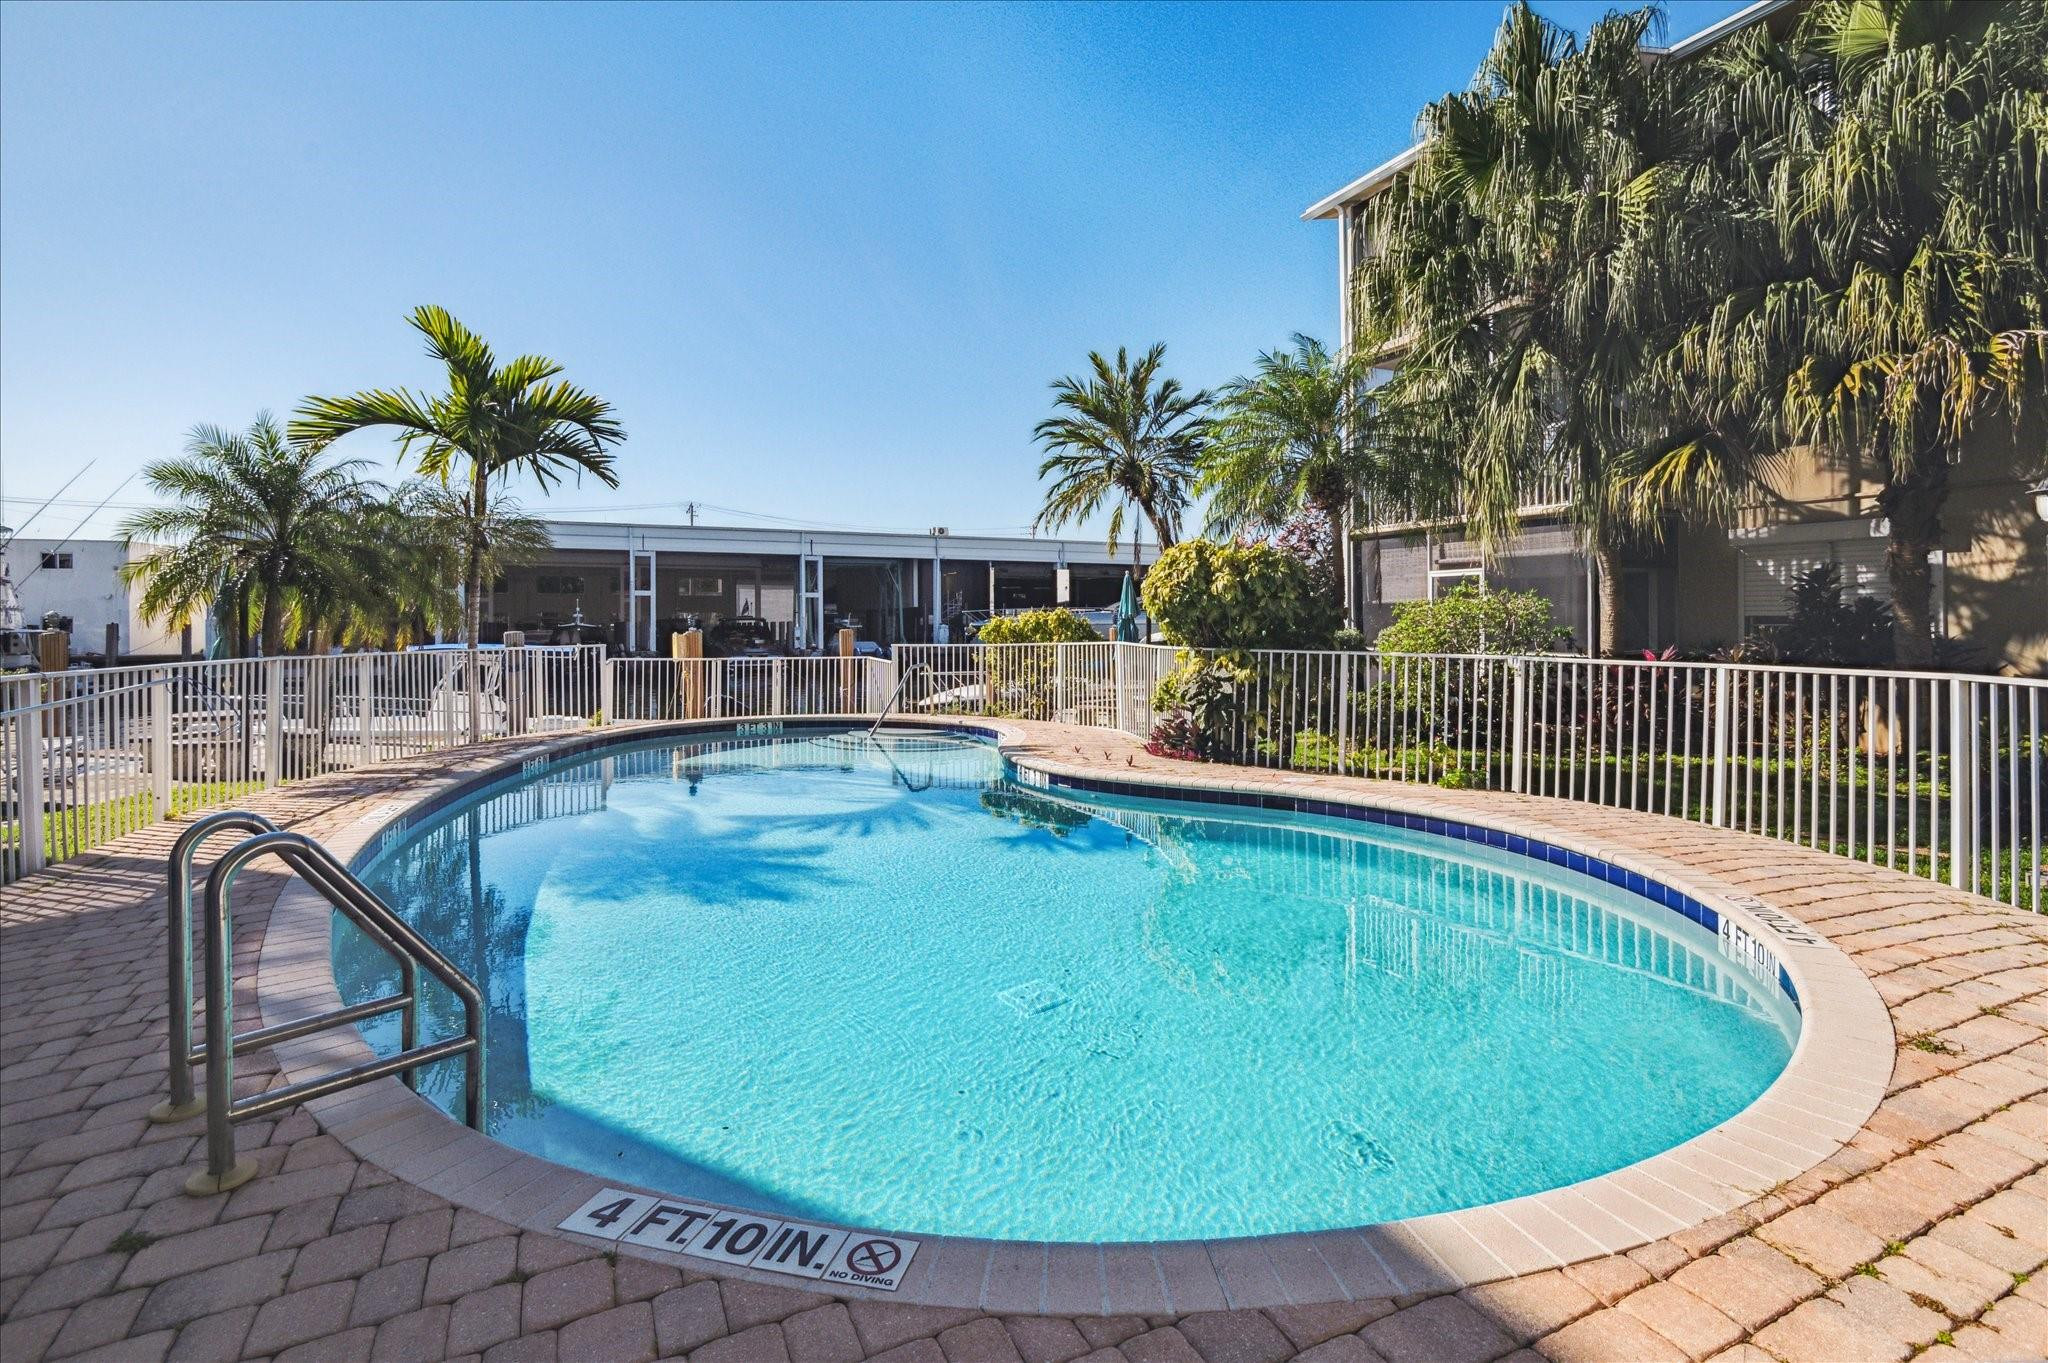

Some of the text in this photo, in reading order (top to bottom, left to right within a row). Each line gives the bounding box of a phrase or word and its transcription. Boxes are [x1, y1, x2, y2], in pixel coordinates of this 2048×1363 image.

[1723, 919, 1730, 940] 4
[1752, 938, 1764, 965] 10
[587, 1198, 829, 1270] 4 FT. 10 IN.
[829, 1270, 894, 1286] NO DIVING
